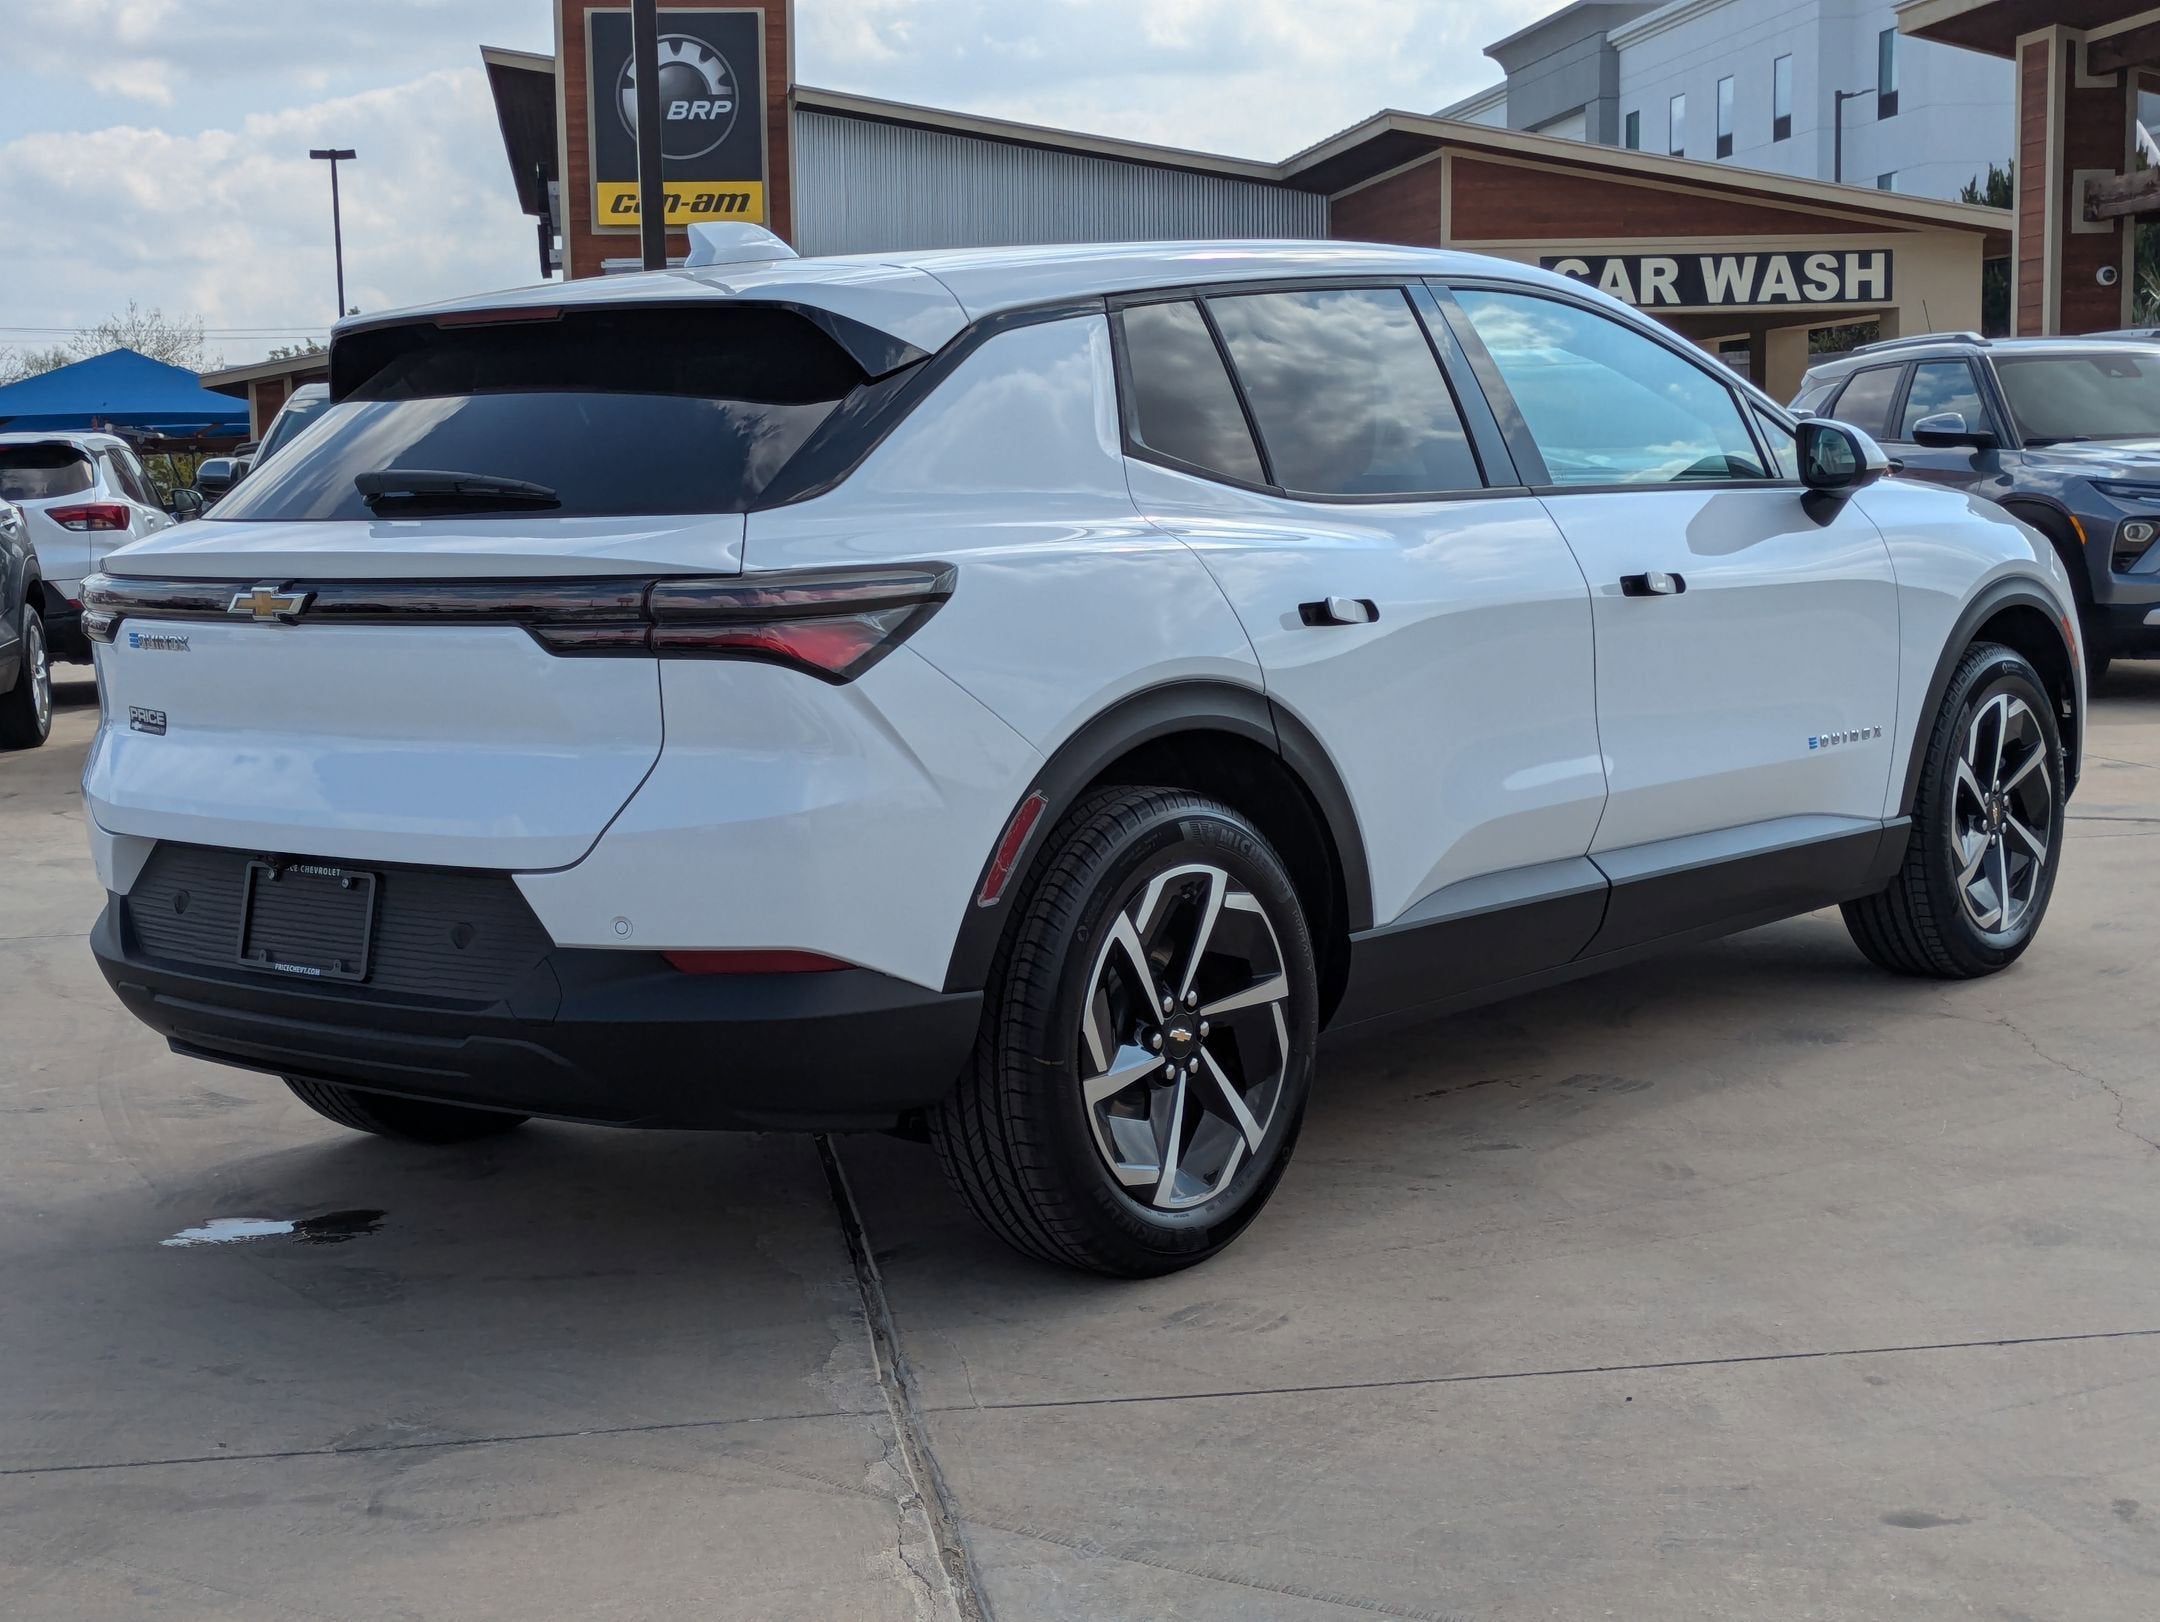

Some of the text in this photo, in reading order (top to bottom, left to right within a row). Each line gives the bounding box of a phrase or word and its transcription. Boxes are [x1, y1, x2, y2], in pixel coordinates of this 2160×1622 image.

[667, 101, 732, 120] BRP
[610, 193, 750, 214] cn-am
[1700, 252, 1885, 304] WASH
[130, 708, 165, 726] PRICE
[1808, 725, 1882, 749] EQUINOX
[300, 864, 341, 877] CHEVROLET
